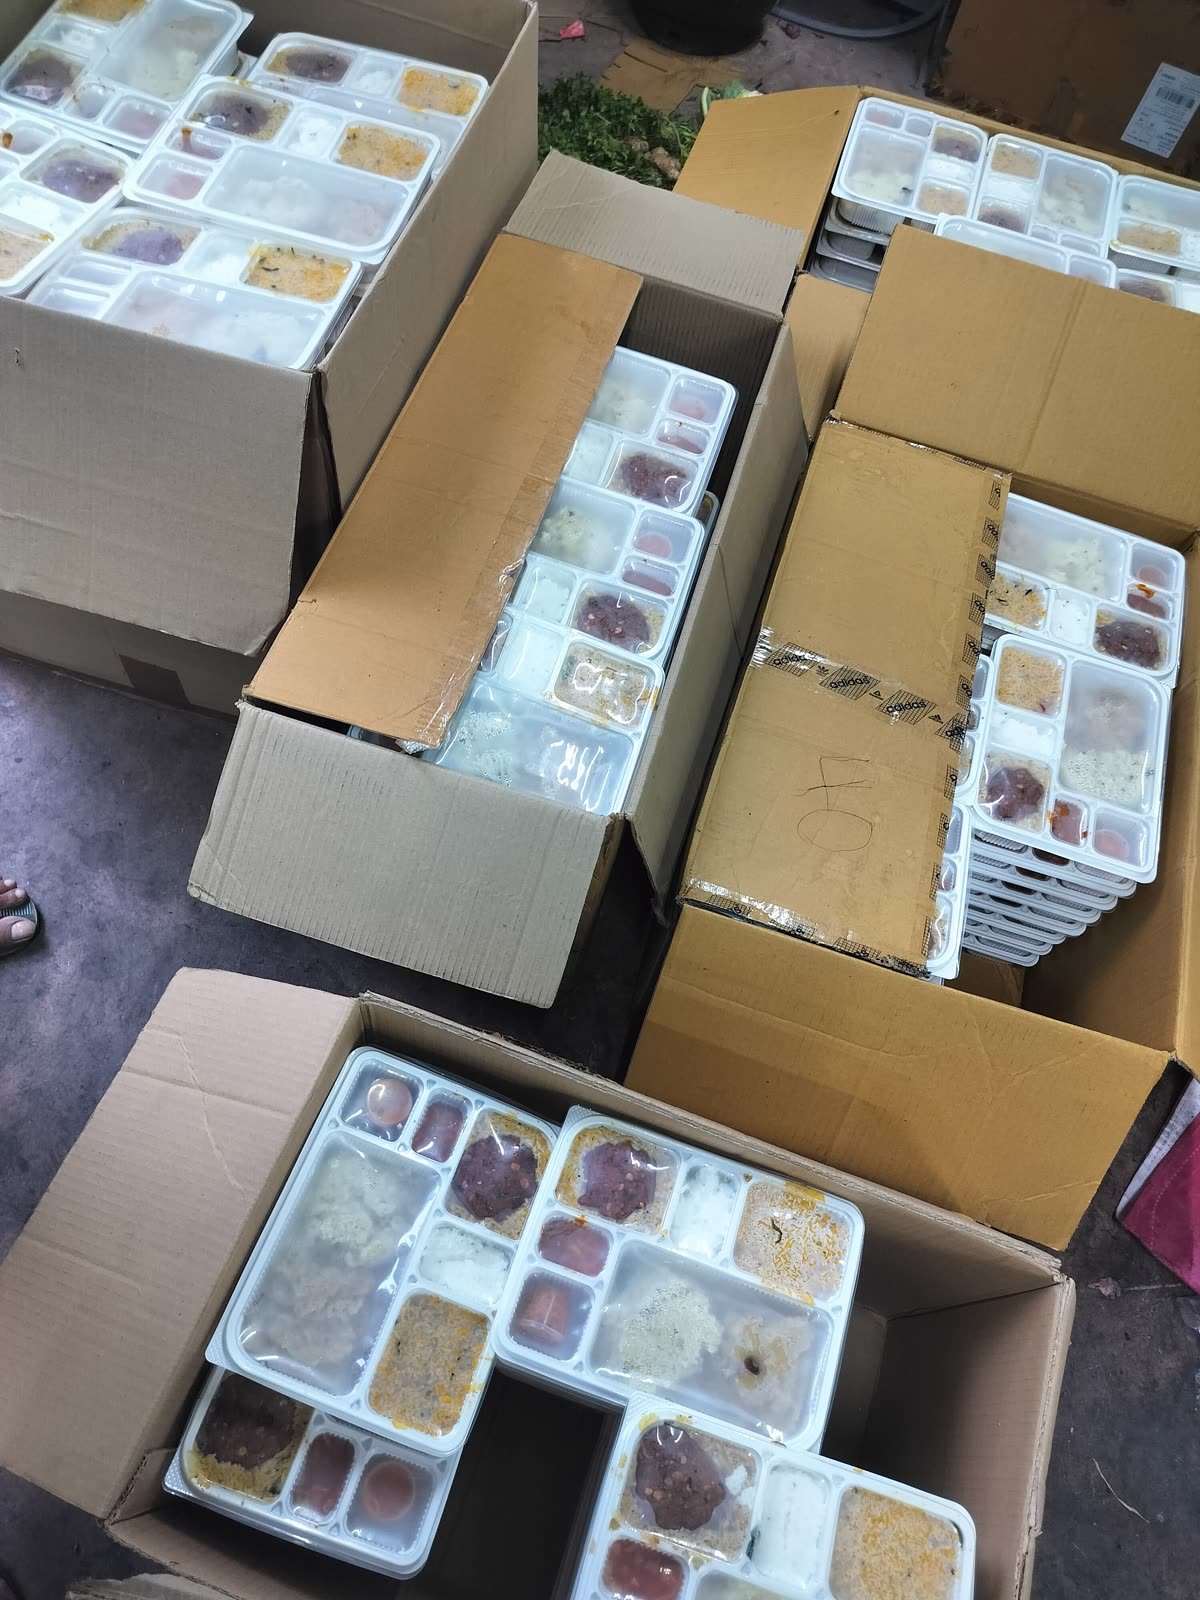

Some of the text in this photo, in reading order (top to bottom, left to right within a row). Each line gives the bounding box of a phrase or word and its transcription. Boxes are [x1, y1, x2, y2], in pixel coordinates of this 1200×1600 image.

[773, 653, 812, 665] adida
[829, 676, 870, 689] adidas
[886, 699, 927, 713] adidas
